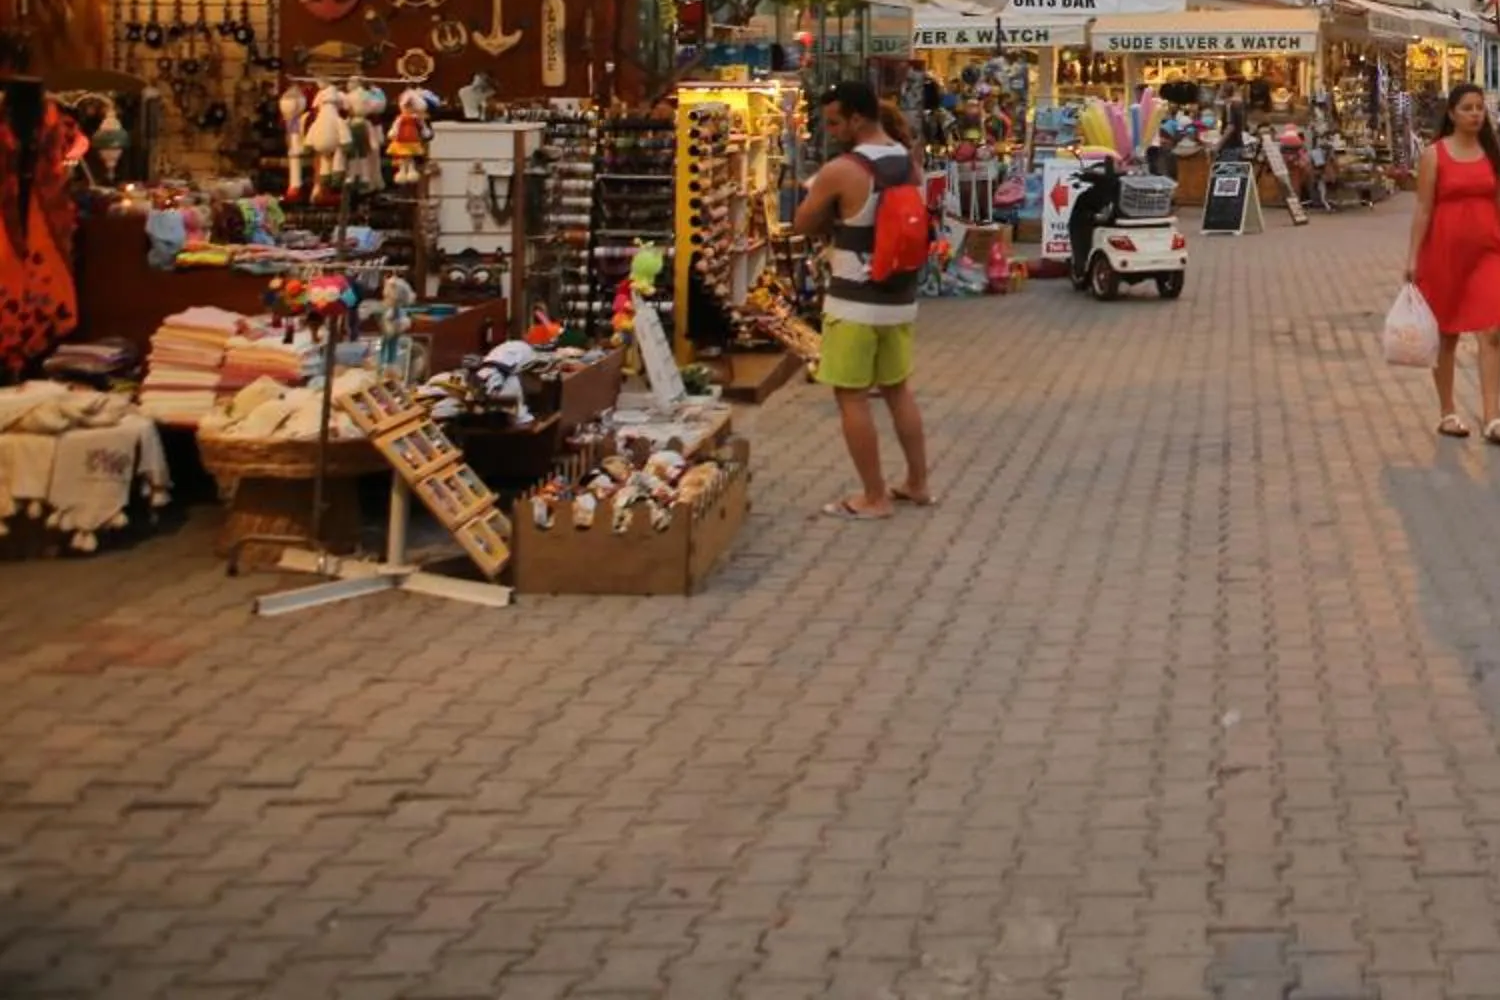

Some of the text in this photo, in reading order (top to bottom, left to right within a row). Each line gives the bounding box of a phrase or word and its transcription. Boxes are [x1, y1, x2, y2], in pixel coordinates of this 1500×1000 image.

[955, 31, 969, 43] &
[1109, 36, 1300, 50] SUDE SILVER & WATCH
